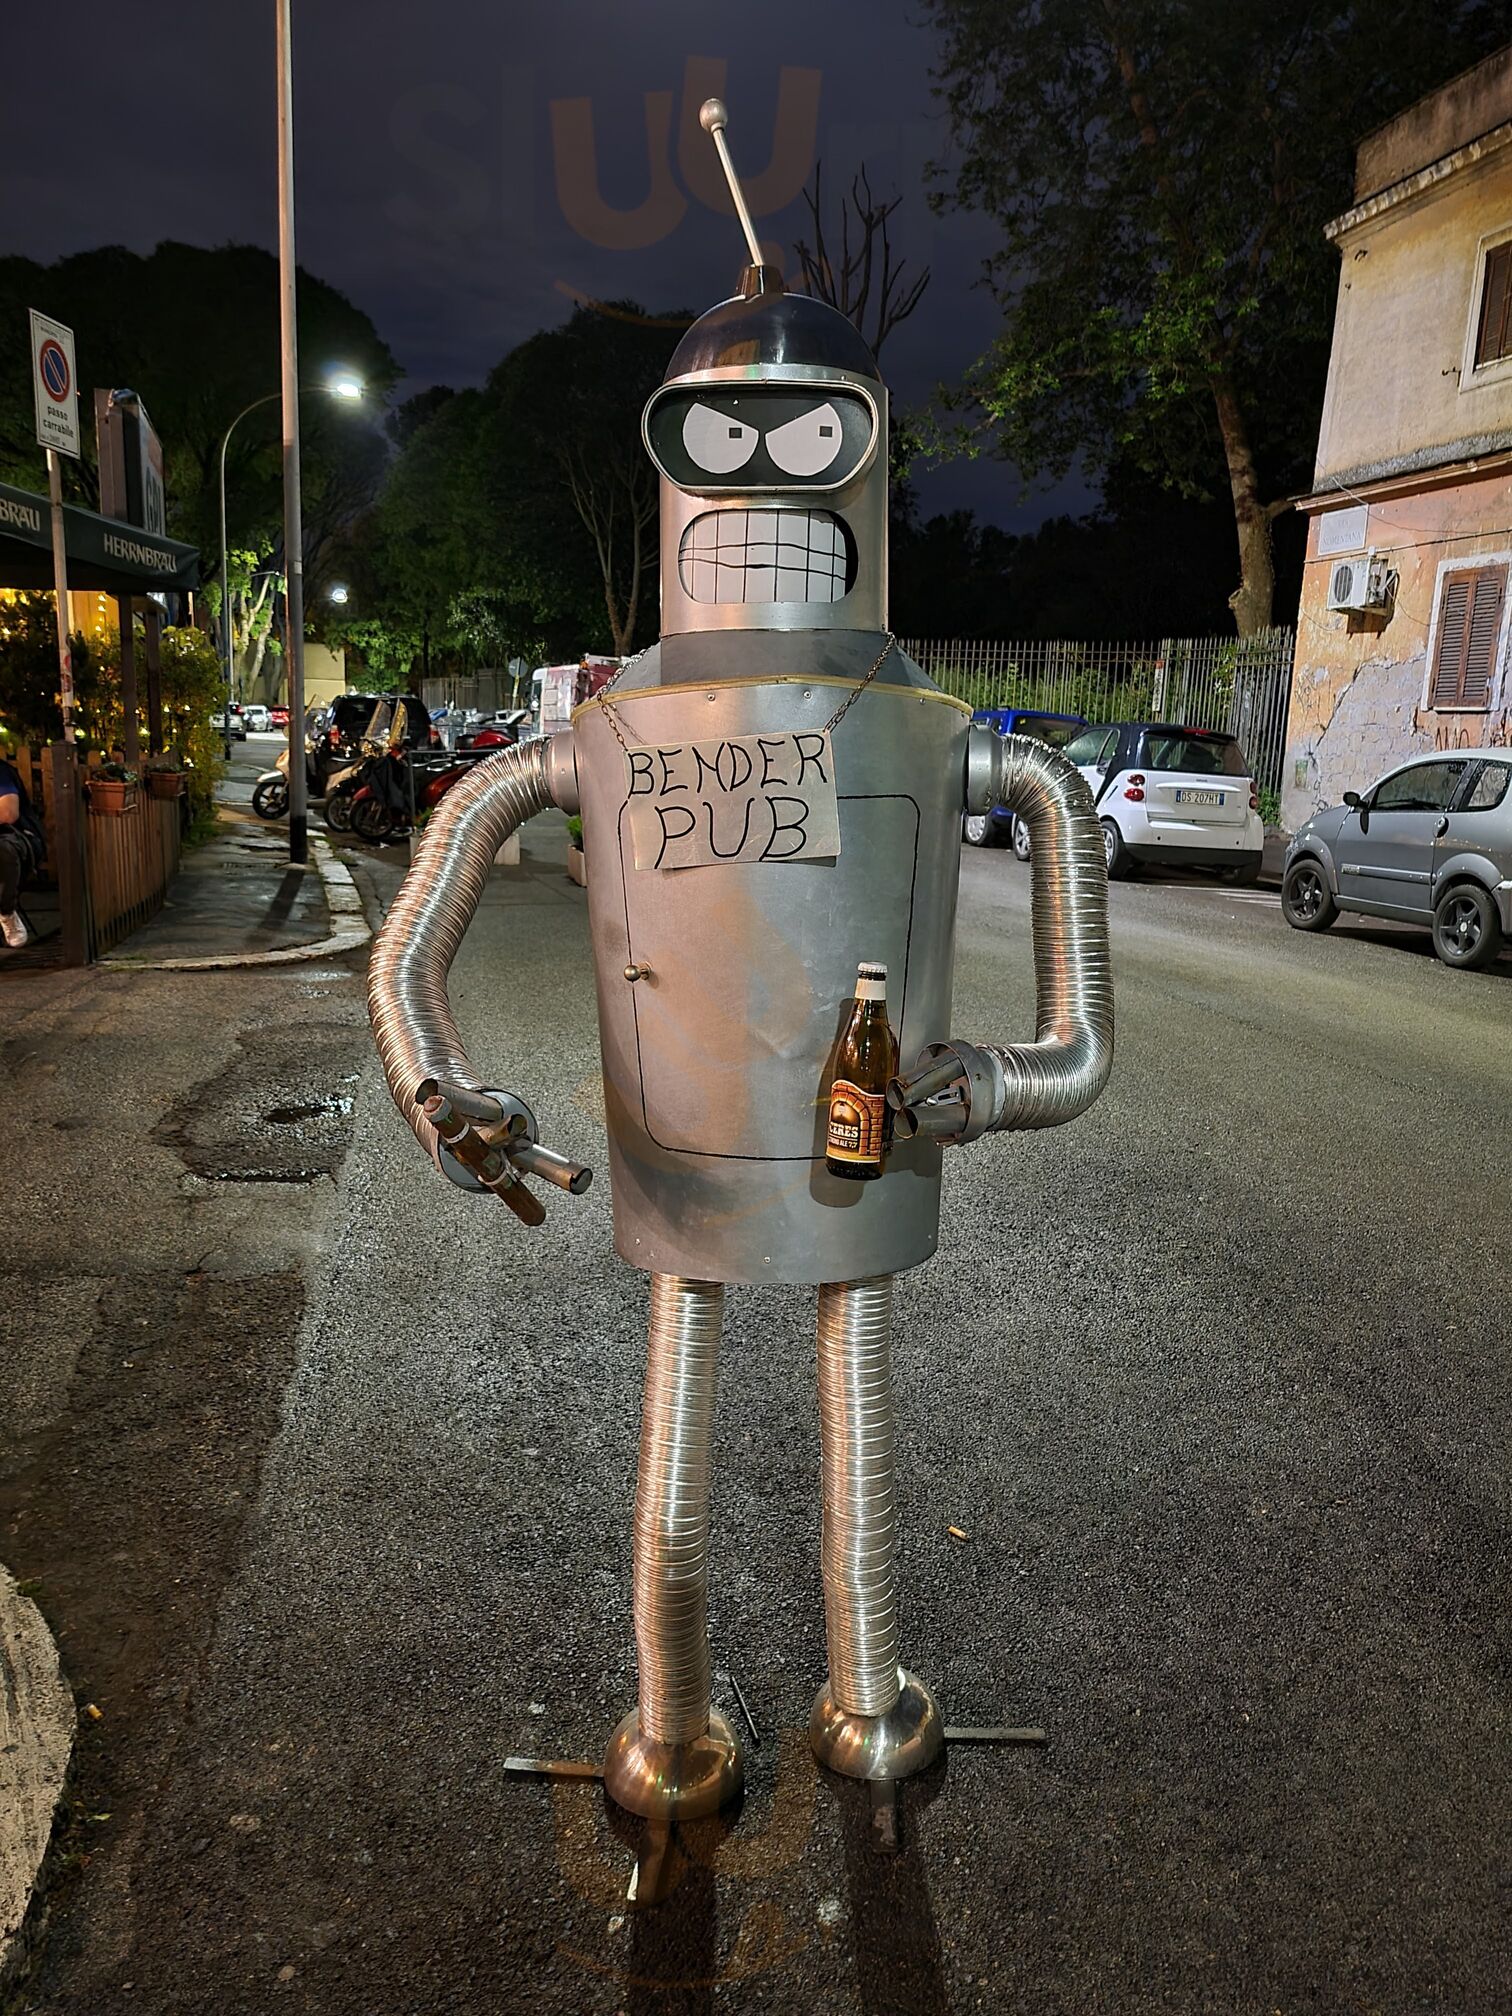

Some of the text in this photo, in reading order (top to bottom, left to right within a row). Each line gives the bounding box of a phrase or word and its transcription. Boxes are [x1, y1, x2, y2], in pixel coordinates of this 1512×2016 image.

[43, 419, 74, 438] carrabile
[47, 406, 68, 421] passo
[103, 533, 177, 573] HERRNBRÄU
[627, 734, 828, 800] BENDER
[654, 796, 810, 870] PUB
